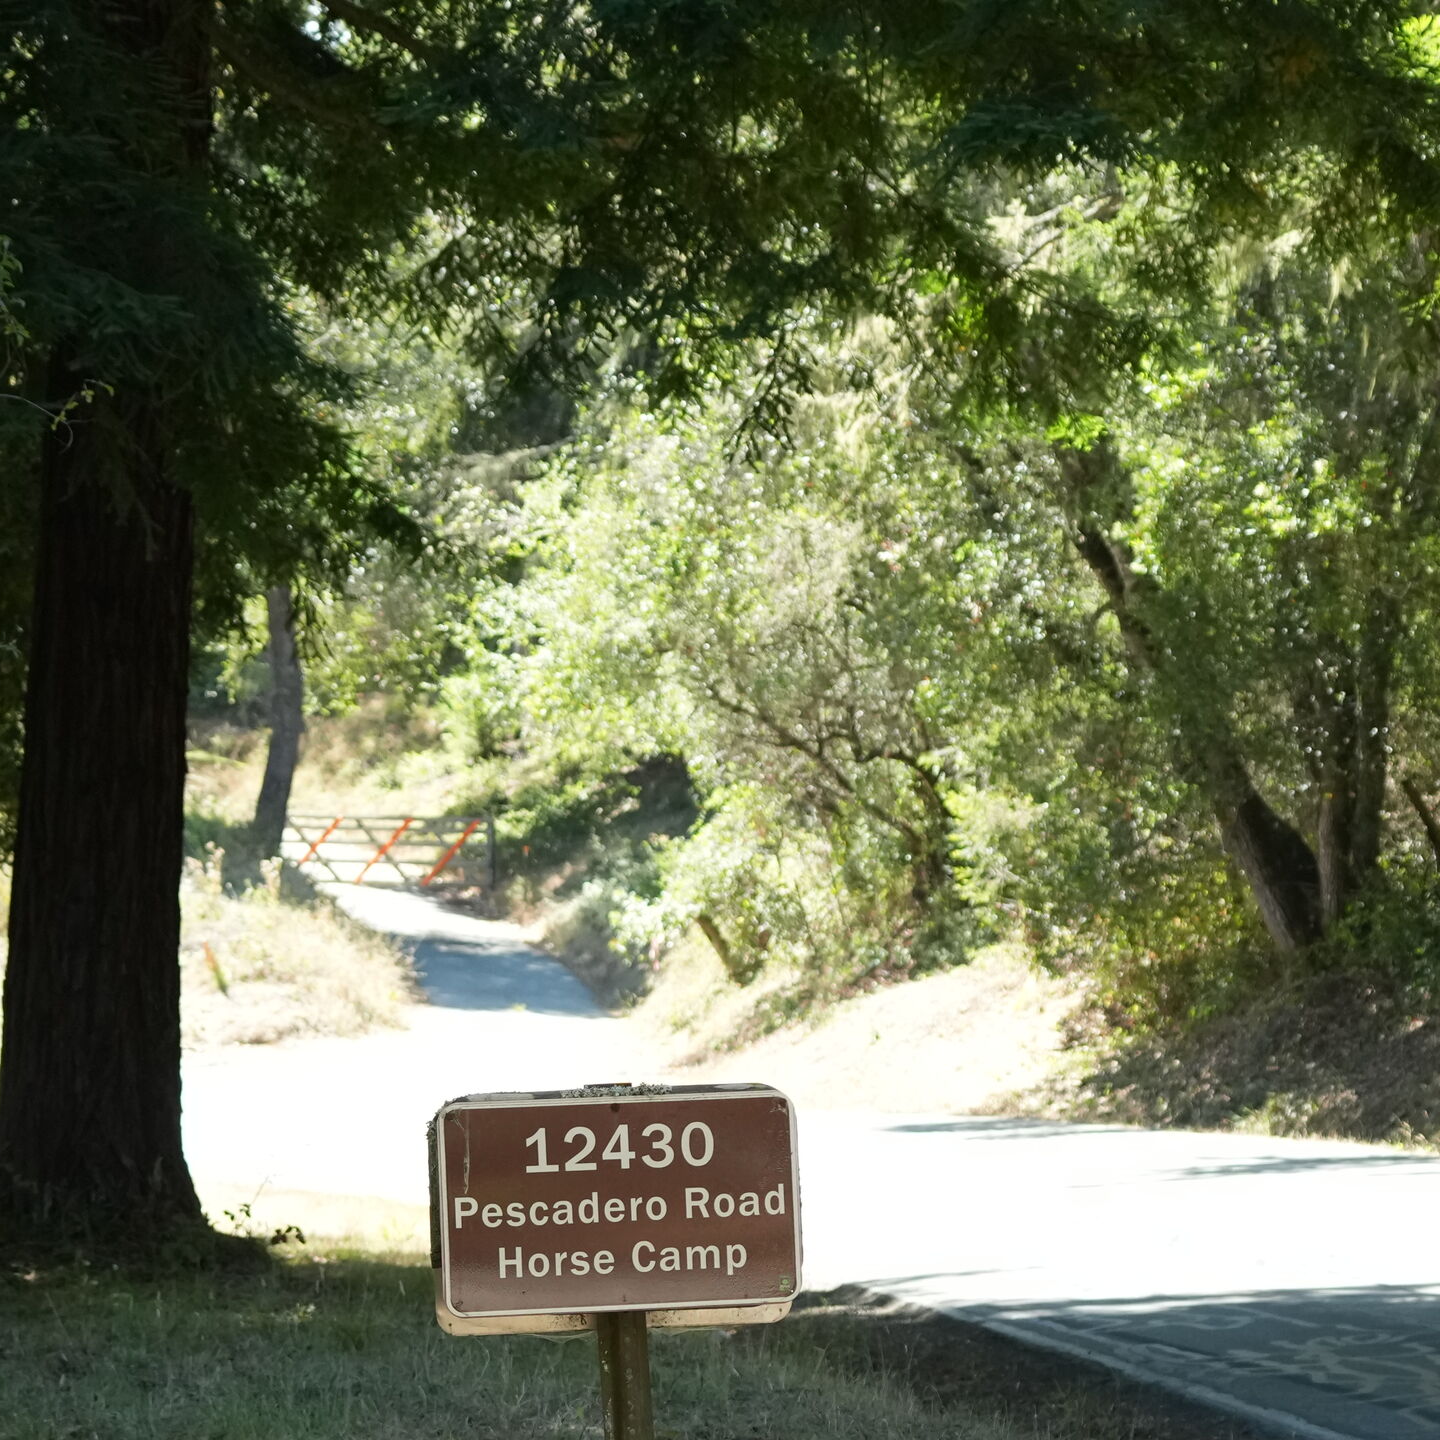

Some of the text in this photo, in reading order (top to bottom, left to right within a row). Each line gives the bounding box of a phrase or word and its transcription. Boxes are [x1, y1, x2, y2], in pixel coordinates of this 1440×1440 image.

[525, 1121, 715, 1174] 12430
[454, 1183, 786, 1229] Pescadero Road
[498, 1240, 748, 1279] Horse Camp
